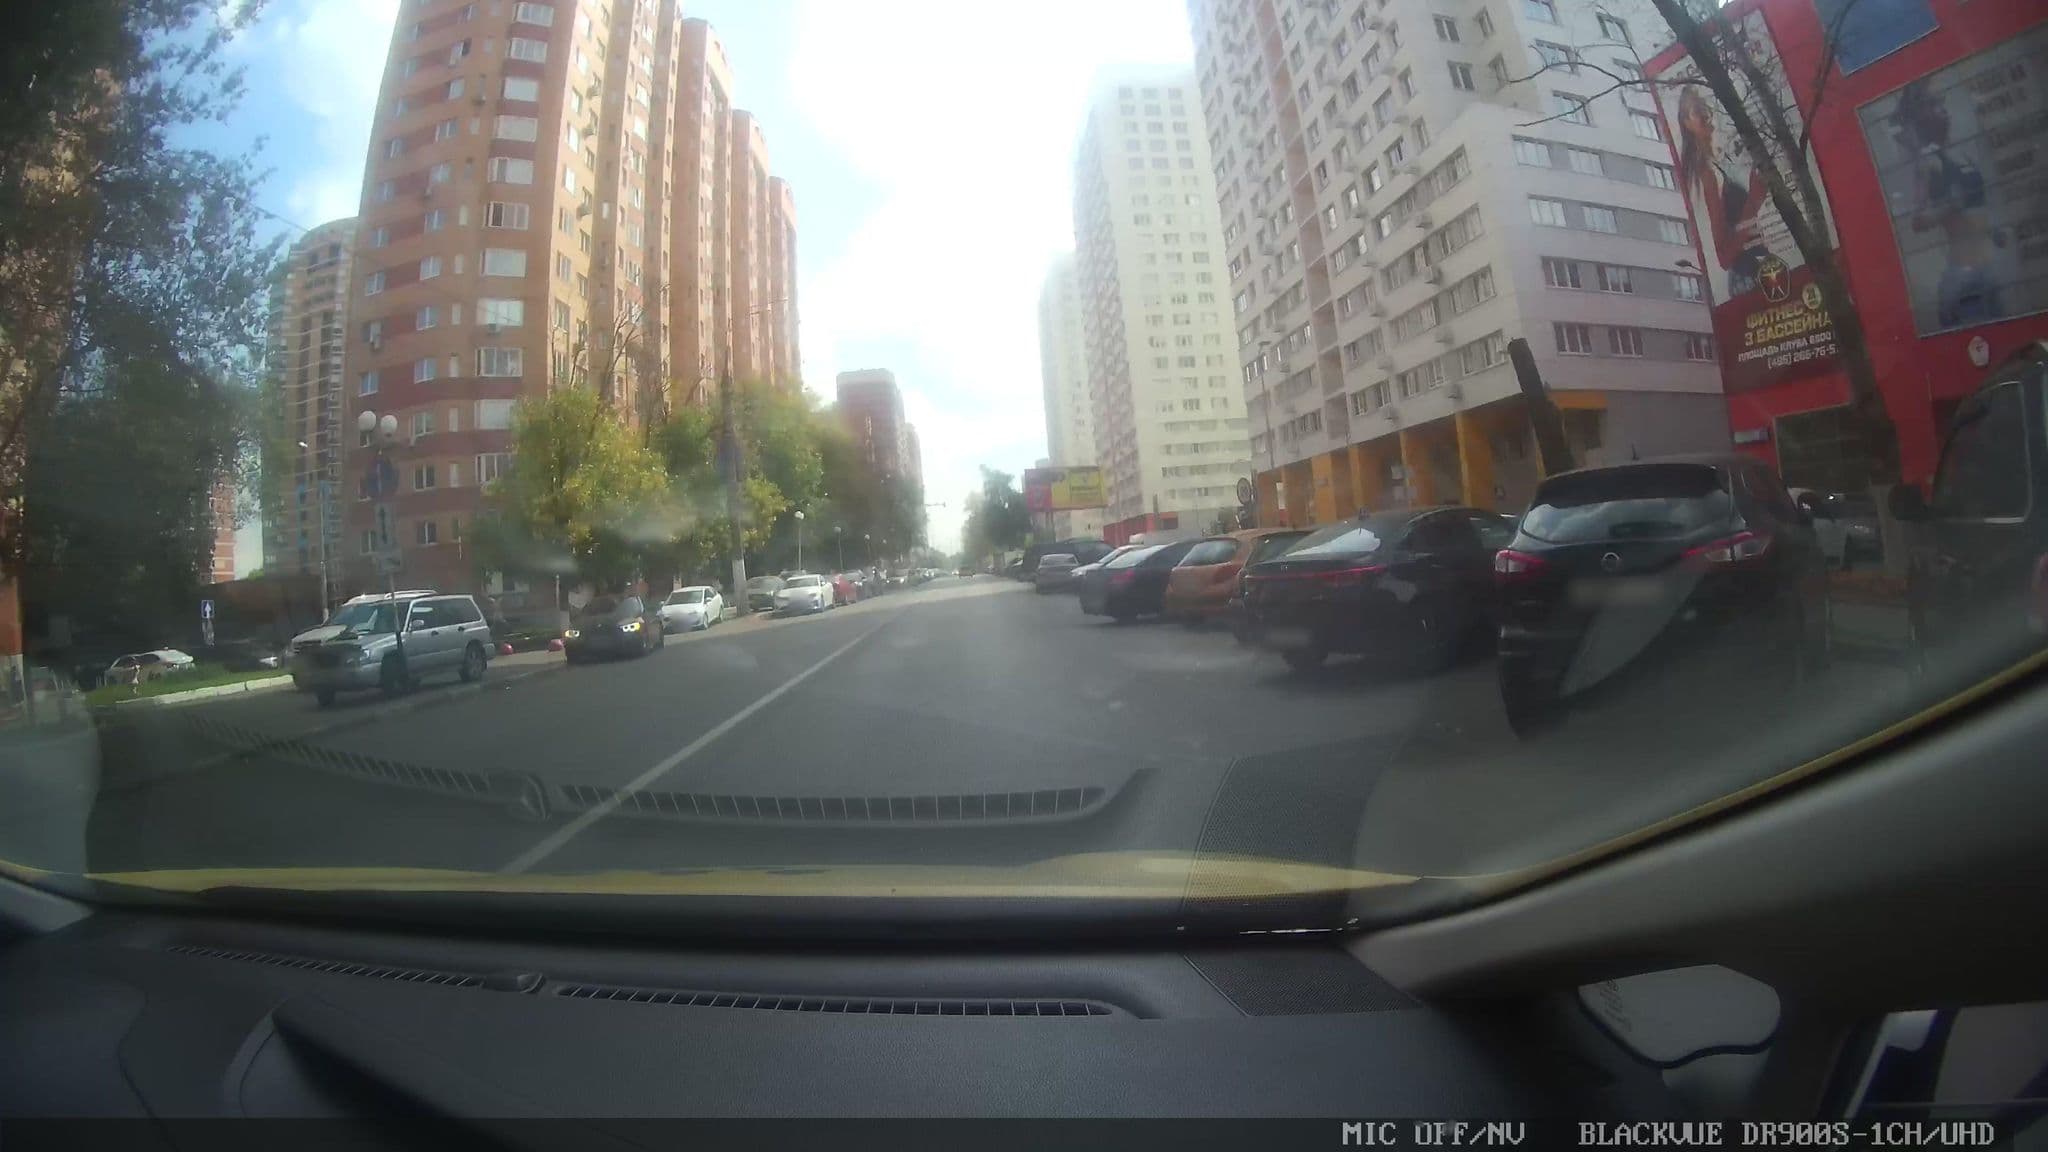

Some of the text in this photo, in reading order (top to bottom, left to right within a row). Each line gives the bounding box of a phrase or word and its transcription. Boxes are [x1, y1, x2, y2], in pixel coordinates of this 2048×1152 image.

[1746, 305, 1803, 329] ФИТНЕС
[1737, 344, 1779, 362] ПЛОЩАДЬ
[1780, 338, 1808, 353] КЛУБА
